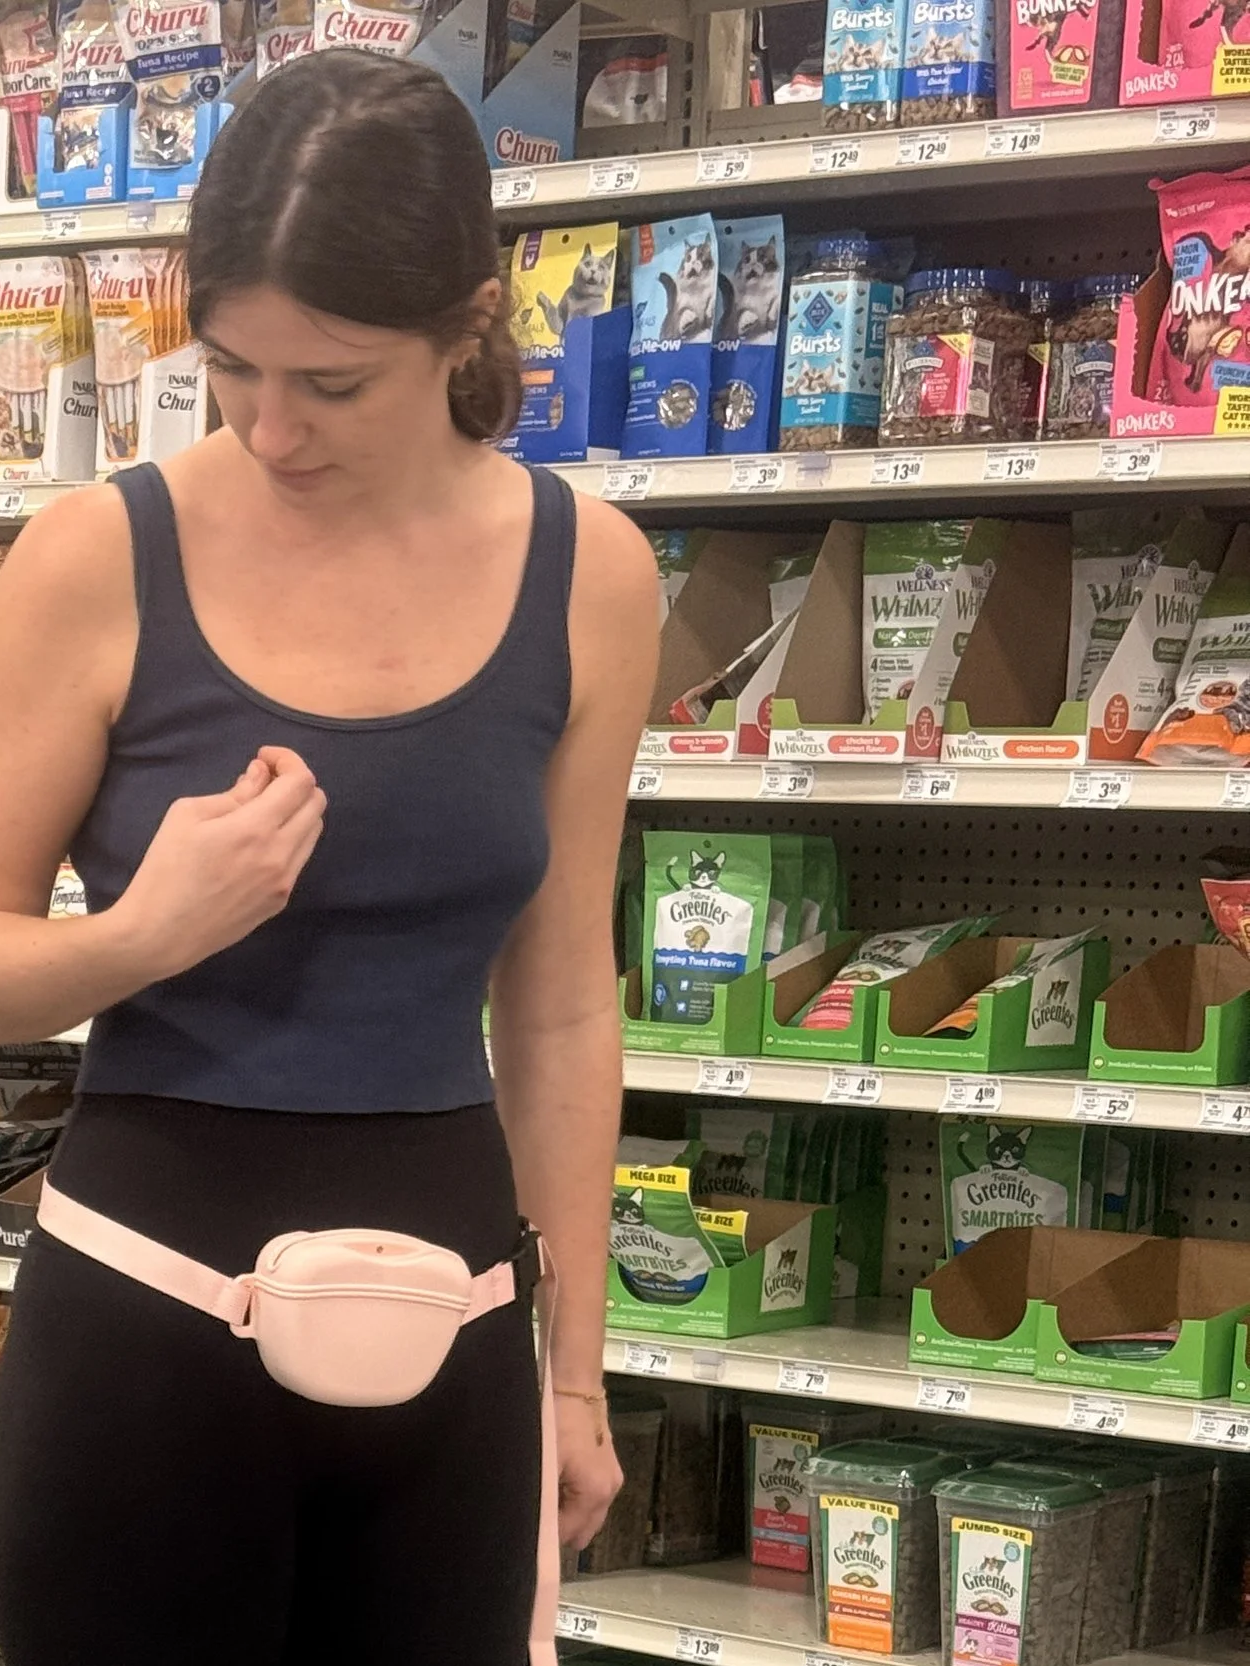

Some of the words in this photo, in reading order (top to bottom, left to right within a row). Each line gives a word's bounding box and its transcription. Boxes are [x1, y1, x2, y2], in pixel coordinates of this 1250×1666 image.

[125, 4, 207, 37] Churu
[831, 7, 894, 31] Bursts
[912, 1, 975, 25] Bursts
[323, 11, 410, 42] Churu
[61, 38, 125, 70] Churu
[136, 58, 162, 70] Tuna
[163, 50, 200, 65] Recipe
[203, 77, 214, 92] 2
[1125, 73, 1179, 99] BONKERS
[88, 267, 145, 301] Churu
[790, 336, 841, 355] Bursts
[1116, 410, 1177, 433] BONKERS
[896, 577, 952, 593] WELLNESS
[871, 595, 943, 623] WHIMZ
[870, 657, 878, 672] 4
[1157, 677, 1165, 696] 4
[774, 742, 825, 757] WHIMZEES
[946, 745, 1001, 760] WHIMZEES
[670, 899, 733, 925] Greenies
[1031, 1002, 1076, 1030] Greenies
[630, 1170, 655, 1182] MEGA
[657, 1173, 677, 1185] SIZE
[966, 1180, 1041, 1209] Greenies
[695, 1213, 712, 1223] EGA
[714, 1215, 734, 1227] SIZE
[764, 1268, 804, 1298] Greenies
[754, 1426, 789, 1438] VALUE
[792, 1431, 814, 1443] SIZE
[758, 1472, 806, 1494] Greenies
[826, 1497, 867, 1509] VALUE
[869, 1503, 895, 1515] SIZE
[958, 1521, 1000, 1534] JUMBO
[1002, 1529, 1026, 1541] SIZE
[833, 1546, 887, 1571] Greenies
[962, 1573, 1017, 1598] Greenies
